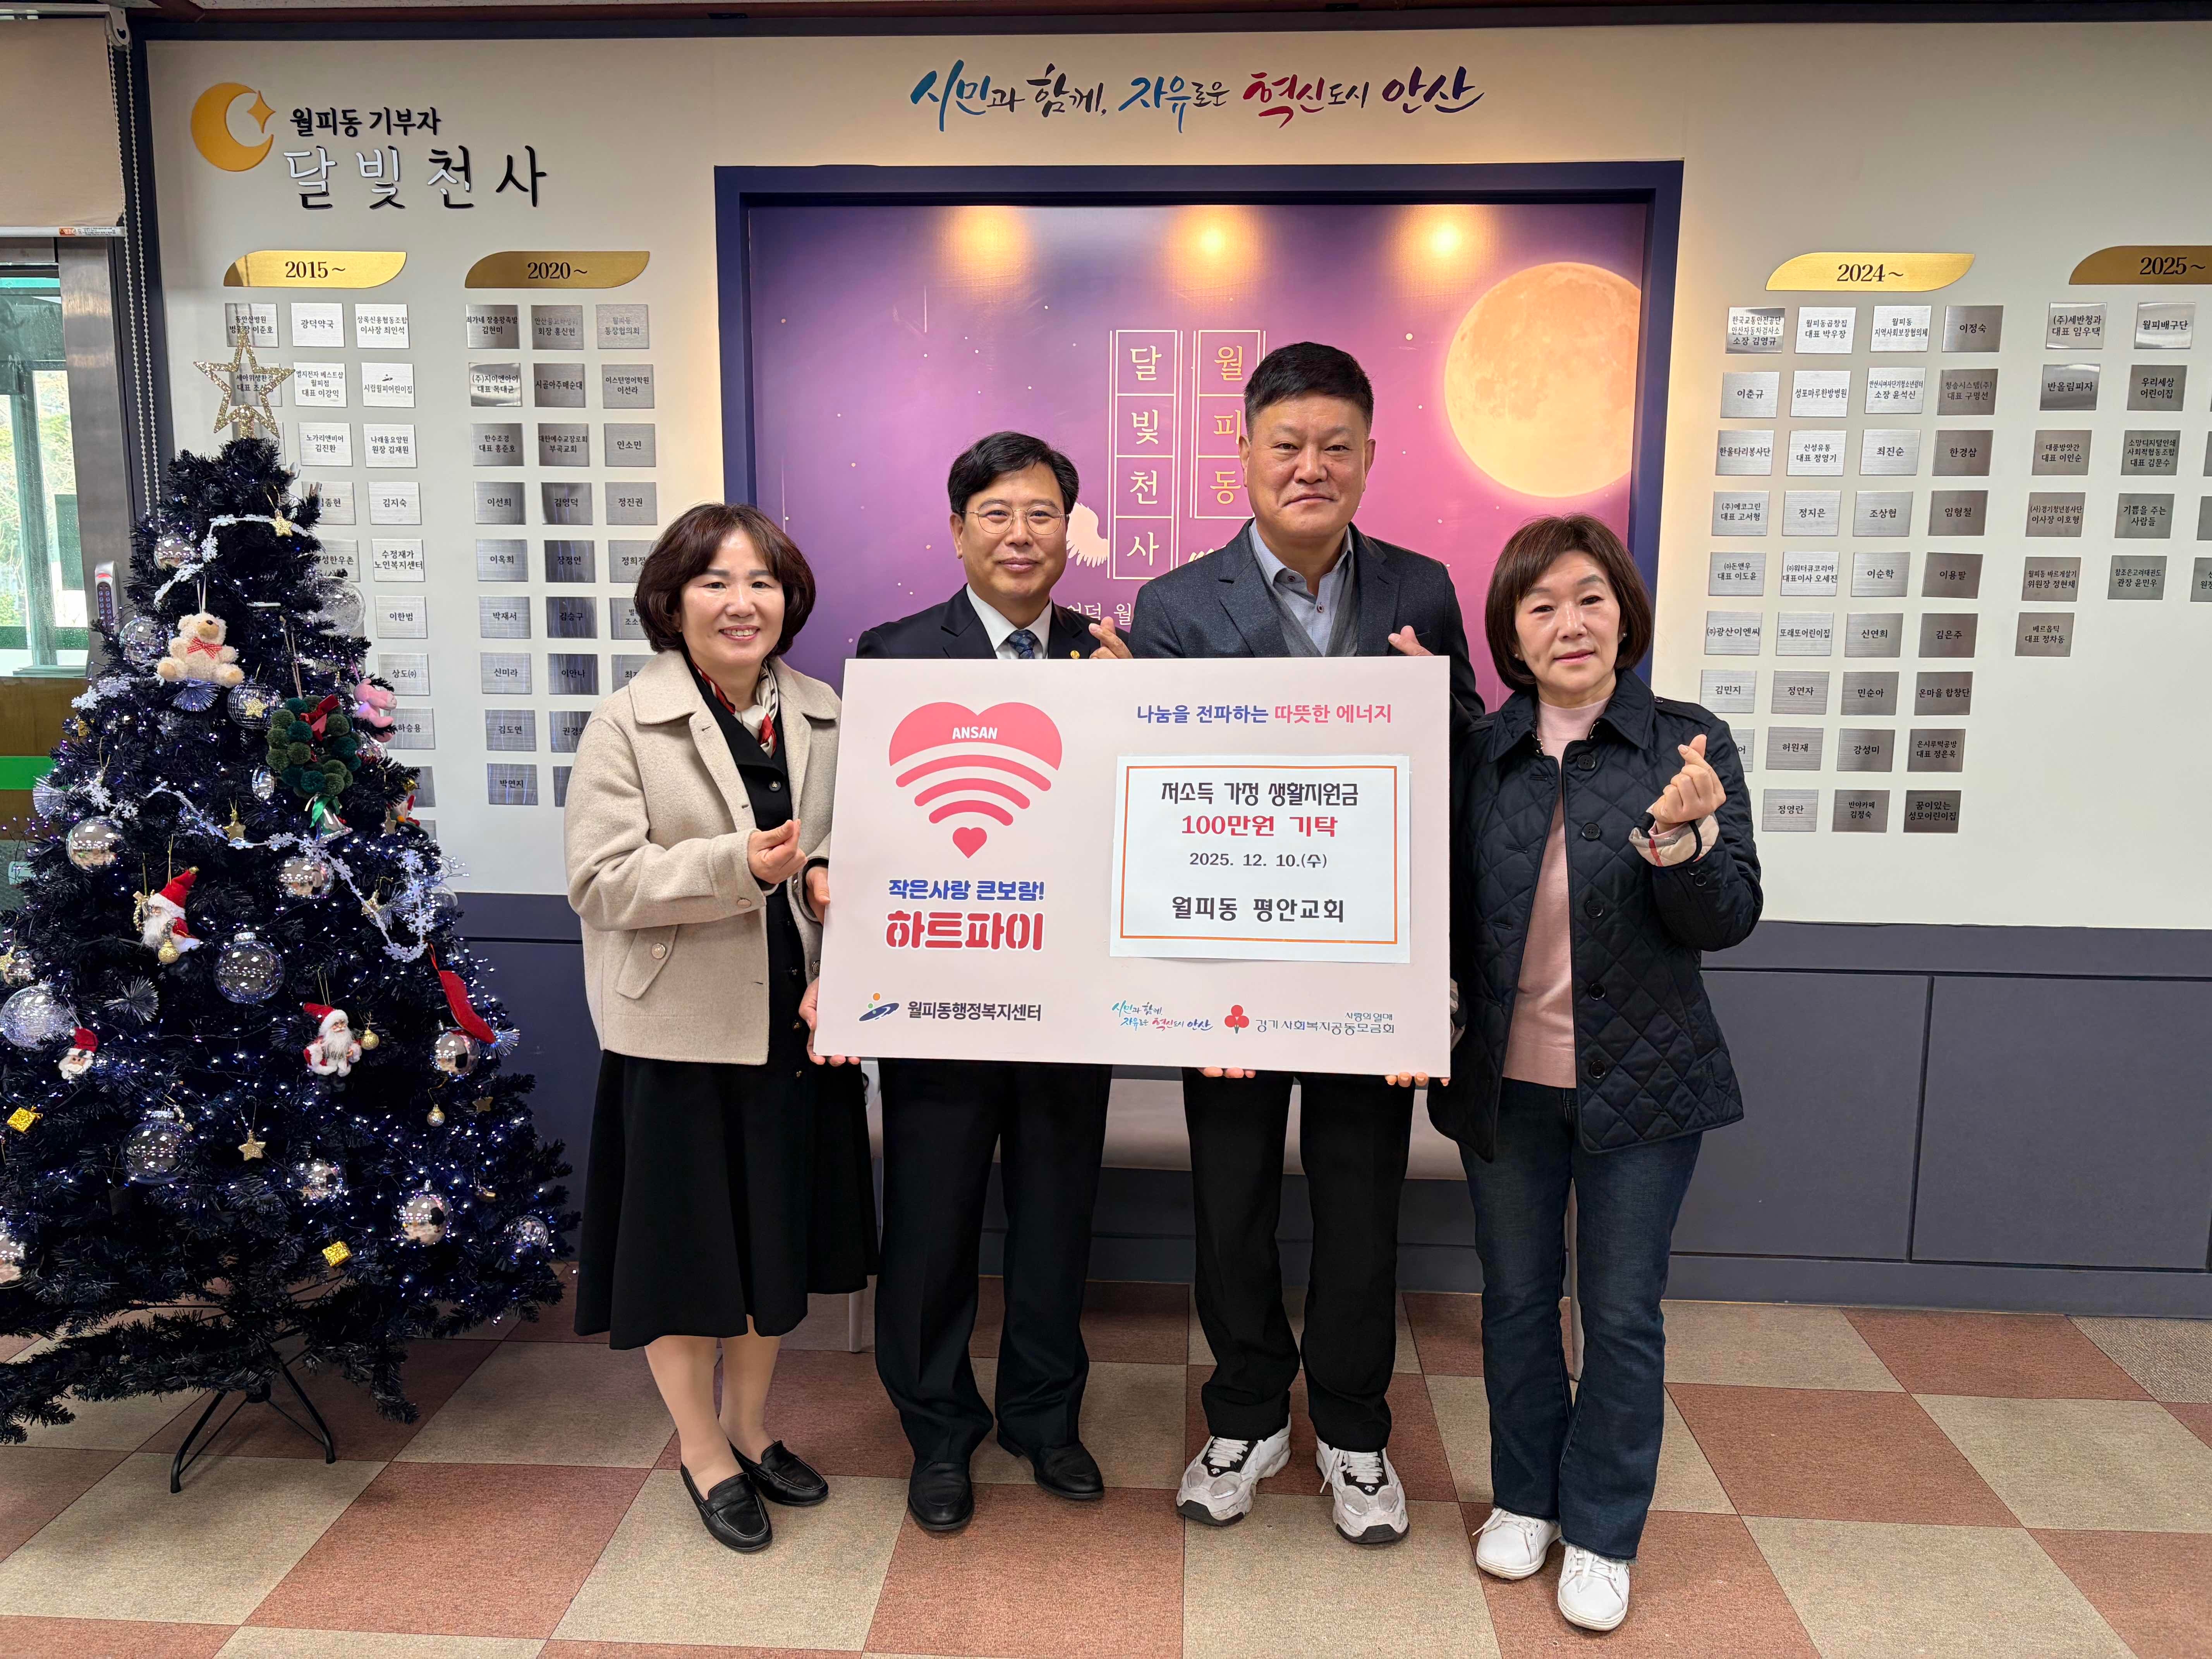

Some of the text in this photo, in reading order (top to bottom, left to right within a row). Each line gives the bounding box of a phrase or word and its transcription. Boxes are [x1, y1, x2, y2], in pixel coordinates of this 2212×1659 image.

[911, 59, 1485, 133] 시민과 함께, 자유로운 혁신도시 안산
[290, 107, 441, 137] 월피동 기부자
[285, 261, 346, 279] 2015~
[527, 261, 588, 279] 2020~
[2140, 257, 2205, 275] 2025~
[1836, 264, 1904, 282] 2024~
[301, 319, 334, 328] 광덕약국
[1733, 316, 1781, 325] 한국교통안전공단
[1806, 319, 1847, 328] 월피동곱창집
[1892, 318, 1912, 326] 월피동
[2053, 315, 2101, 325] (주)세반청과
[1960, 323, 1987, 333] 이정숙
[2143, 320, 2188, 330] 월피배구단
[253, 326, 273, 334] 이준호
[361, 326, 404, 334] 이사장 최인석
[482, 326, 502, 334] 김현미
[538, 327, 551, 335] 회장
[605, 327, 639, 335] 통장협의회
[1732, 326, 1780, 335] 안산자동차검사소
[1805, 330, 1846, 338] 대표 박우장
[1875, 328, 1928, 337] 지역사회보장협의체
[2052, 327, 2100, 337] 대표 임우택
[1733, 337, 1777, 345] 소장 김영규
[536, 381, 582, 390] 시골아주매순대
[2048, 382, 2093, 392] 반올림피자
[2142, 378, 2174, 387] 우리세상
[364, 385, 412, 394] 시립월피어린이집
[617, 386, 637, 395] 이선라
[1737, 389, 1764, 398] 이춘규
[1795, 388, 1847, 398] 성포마루한방병원
[2141, 389, 2173, 398] 어린이집
[1874, 390, 1915, 399] 소장 윤석신
[1965, 392, 1988, 400] 구명선
[315, 444, 336, 453] 김진환
[495, 445, 515, 453] 홍준호
[617, 440, 641, 450] 인소민
[2046, 444, 2080, 452] 대풍방앗간
[372, 446, 385, 454] 원장
[1720, 447, 1771, 457] 한울타리봉사단
[1877, 447, 1905, 456] 최진순
[1950, 448, 1977, 457] 한경삼
[2059, 454, 2082, 462] 이인순
[2148, 459, 2170, 467] 김문수
[383, 498, 407, 507] 김지숙
[487, 498, 511, 507] 이선희
[554, 498, 578, 507] 김영덕
[618, 498, 643, 507] 정진권
[1799, 508, 1826, 518] 정지은
[1869, 509, 1896, 518] 조상협
[1945, 508, 1972, 517] 임형철
[2030, 505, 2083, 514] (사)경기청년봉사단
[2123, 505, 2167, 515] 기쁨을 주는
[1738, 513, 1760, 521] 고서형
[2057, 516, 2080, 524] 이호형
[2131, 517, 2156, 526] 사람들
[382, 550, 414, 559] 수정재가
[374, 560, 422, 569] 노인복지센터
[1735, 572, 1757, 580] 이도윤
[1867, 569, 1894, 579] 이순학
[1940, 570, 1966, 580] 이용팔
[2117, 579, 2157, 587] 관장 윤민우
[390, 612, 413, 621] 이한범
[493, 611, 517, 620] 박재서
[1780, 629, 1830, 638] 또래또어린이집
[1861, 629, 1887, 639] 신연희
[1936, 630, 1962, 639] 김은주
[494, 668, 518, 677] 신미라
[562, 669, 585, 678] 이안나
[1715, 685, 1741, 695] 김민지
[1788, 687, 1814, 696] 정연자
[1858, 689, 1884, 697] 민순아
[1946, 688, 1970, 697] 합창단
[1137, 704, 1391, 724] 나눔을 전파하는 따뜻한 에너지
[498, 726, 522, 734] 김도연
[952, 726, 998, 740] ANSAN
[1783, 743, 1808, 752] 허원재
[1854, 745, 1879, 755] 강성미
[500, 780, 523, 788] 박연지
[1162, 782, 1358, 806] 저소득 가정 생활지원금
[1778, 805, 1804, 814] 정영란
[1916, 801, 1951, 810] 꿈이있는
[1909, 811, 1956, 821] 성모어린이집
[1182, 815, 1338, 837] 100만원 기탁
[1189, 853, 1328, 869] 2025. 12. 10.(수)
[889, 879, 1044, 901] 작은사랑 큰보람!
[1172, 896, 1344, 922] 월피동 평안교회
[886, 910, 1044, 951] 하트파이
[908, 1001, 1041, 1021] 월피동행정복지센터
[1112, 1000, 1142, 1017] 시민과
[1345, 1012, 1393, 1022] 사랑의 열매
[1120, 1017, 1213, 1031] 자유로운 안산
[1256, 1020, 1394, 1035] 경기 사회복지공동모금회
